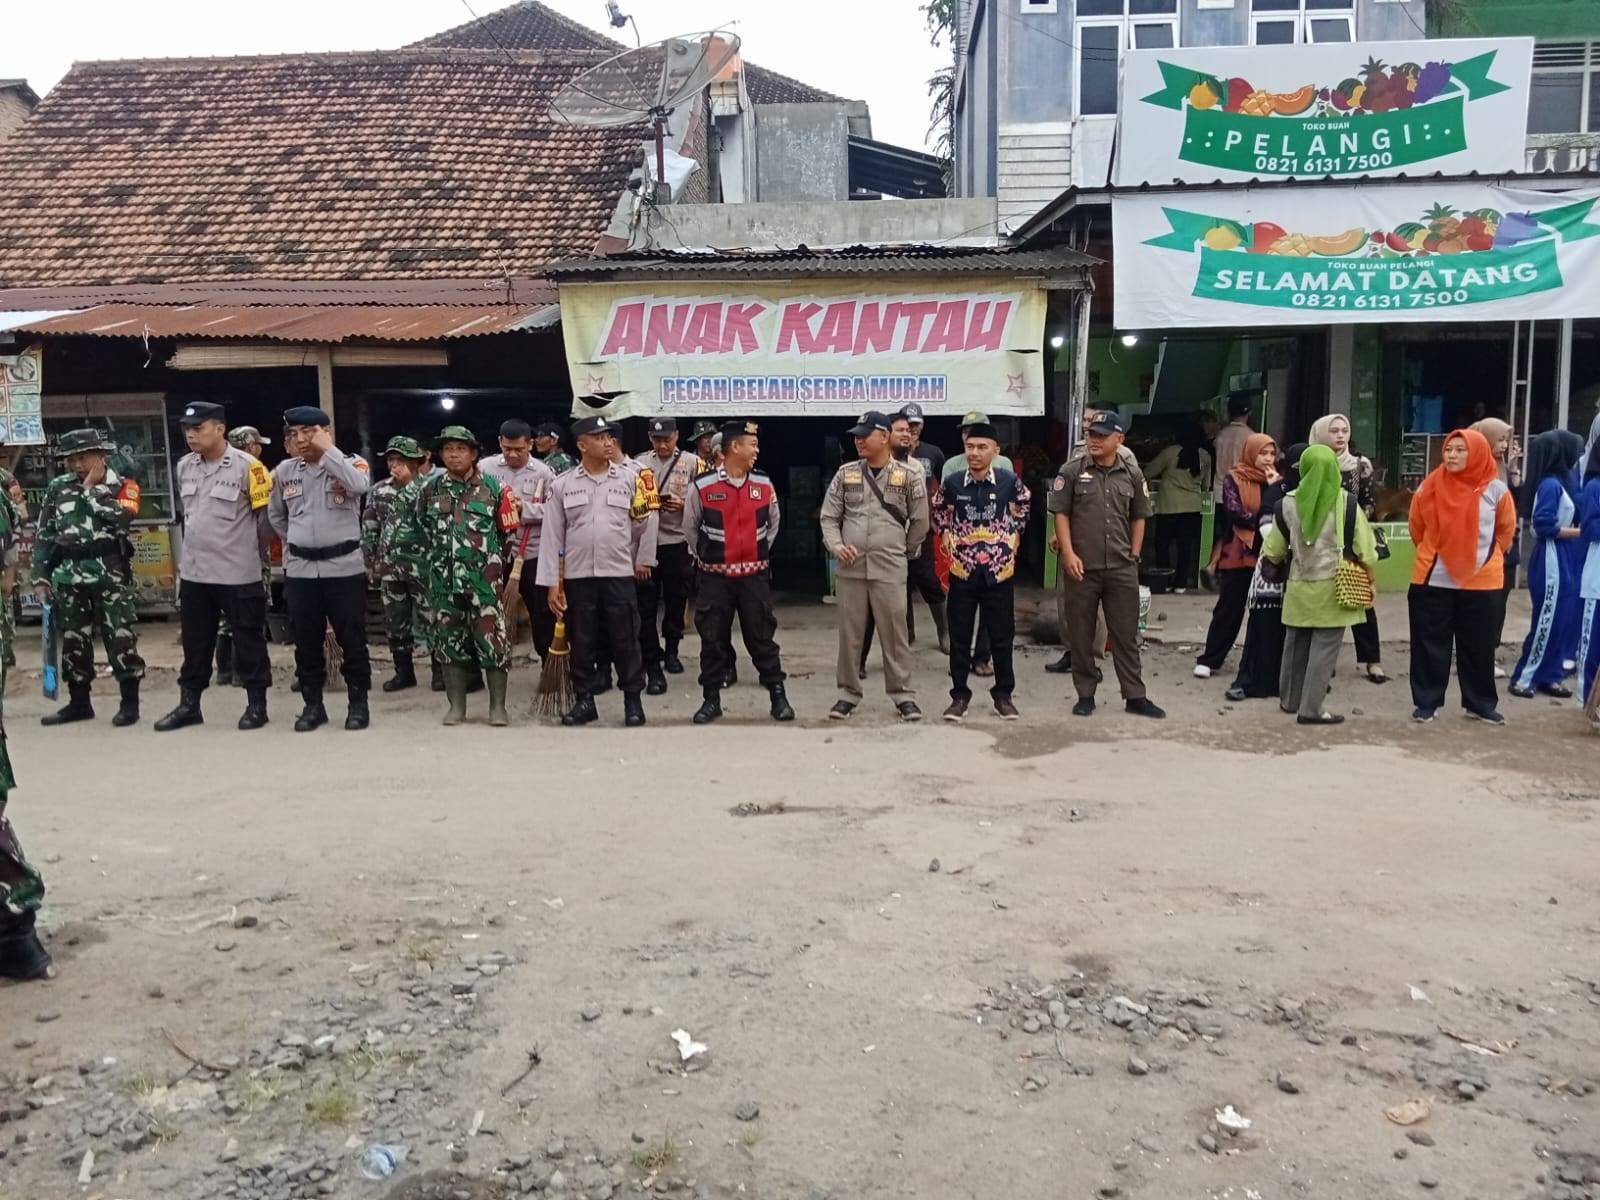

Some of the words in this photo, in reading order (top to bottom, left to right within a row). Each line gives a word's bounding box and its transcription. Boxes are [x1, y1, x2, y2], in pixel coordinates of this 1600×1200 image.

[1302, 122, 1326, 131] TOKO
[1327, 121, 1350, 130] BUAH
[1224, 123, 1412, 156] PELANGI
[1255, 156, 1299, 173] 0821
[1303, 157, 1341, 172] 6131
[1347, 151, 1393, 170] 7500
[1213, 269, 1375, 292] SELAMAT
[1389, 261, 1538, 291] DATANG
[1327, 261, 1356, 270] TOKO
[1359, 262, 1388, 270] BUAH
[1389, 260, 1435, 270] PELANGI
[1291, 293, 1347, 307] 0821
[1354, 293, 1401, 308] 6131
[1408, 289, 1469, 307] 7500
[600, 301, 769, 358] ANAK
[775, 299, 1013, 357] KANTAU
[661, 376, 728, 402] PECAH
[732, 376, 797, 402] BELAH
[798, 375, 866, 402] SERBA
[869, 374, 946, 401] MURAH
